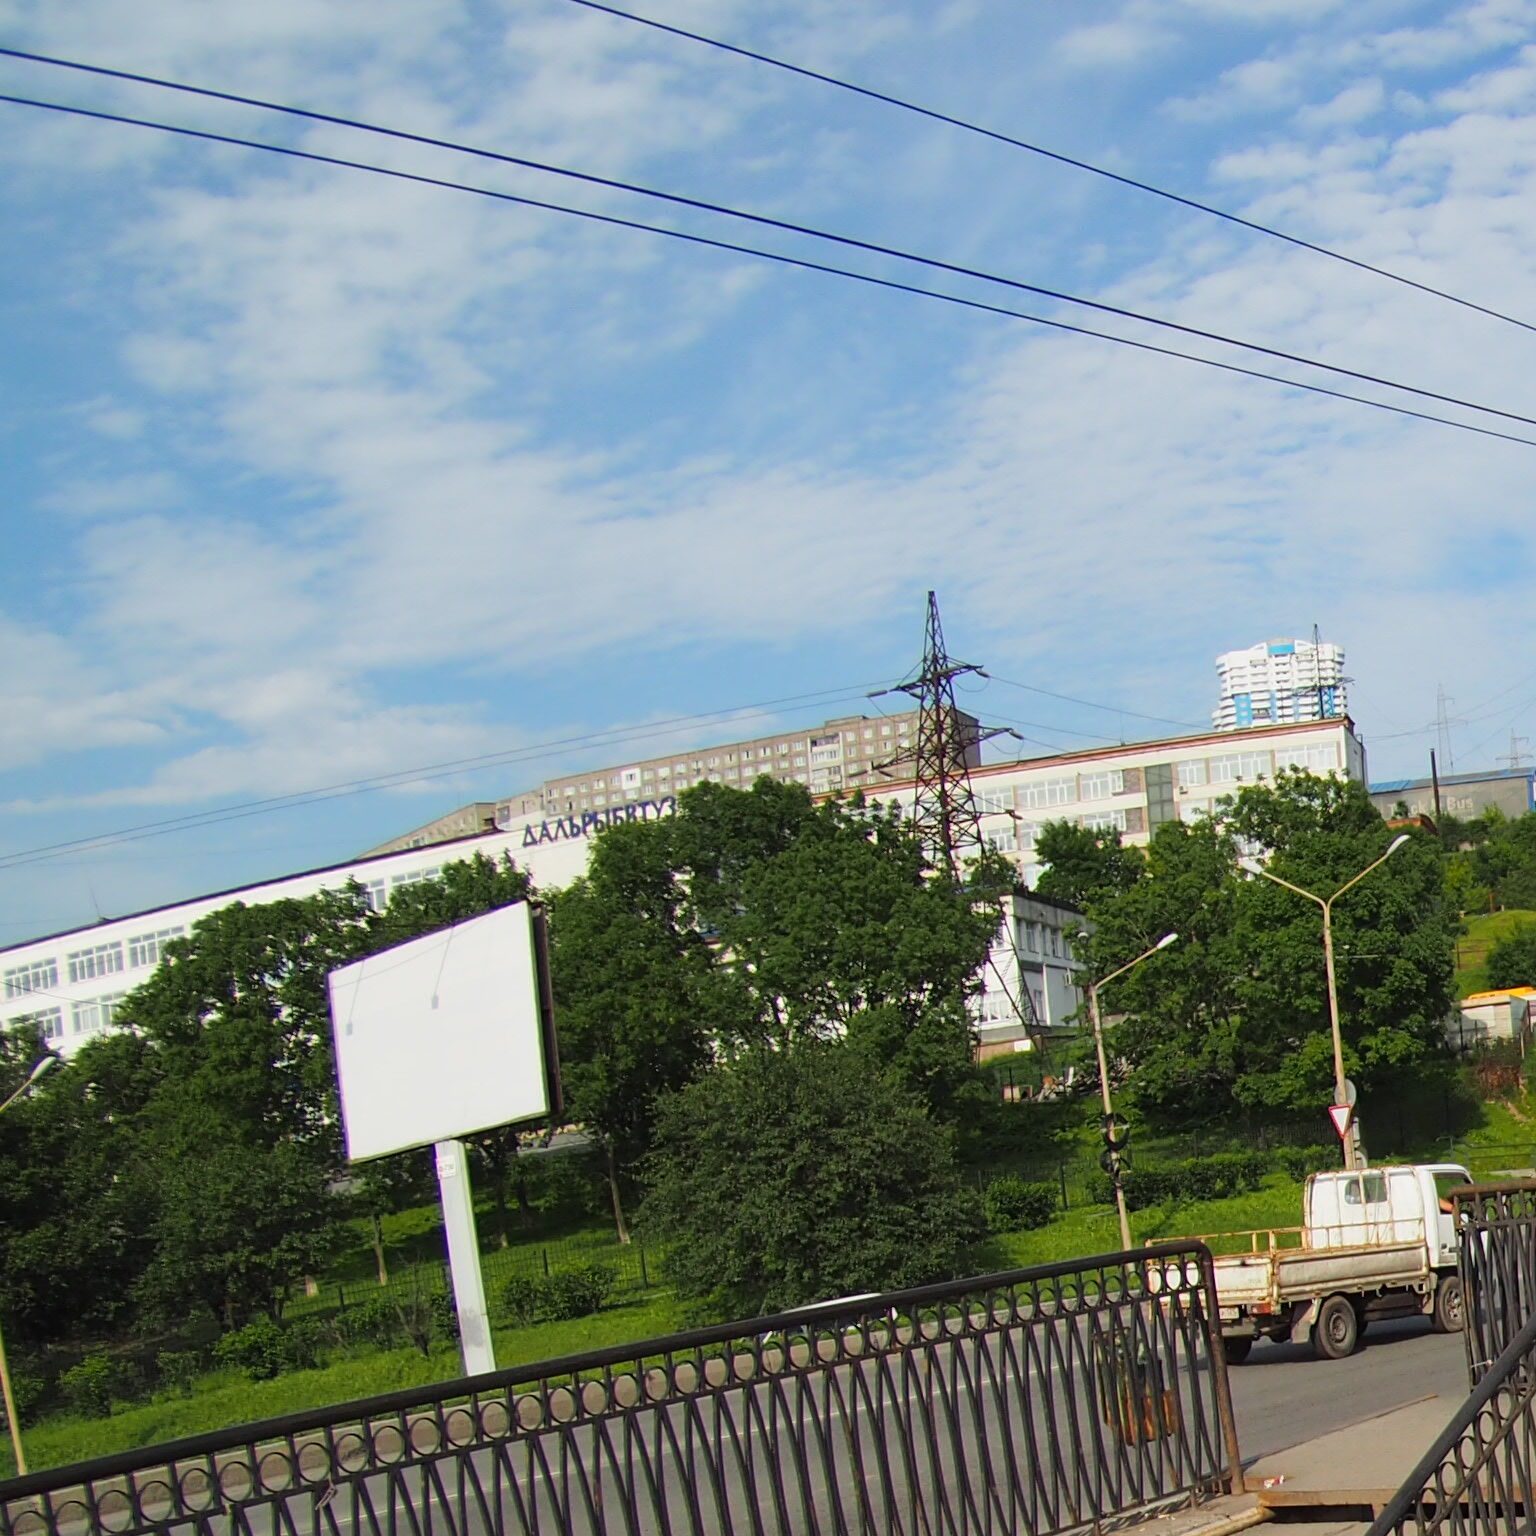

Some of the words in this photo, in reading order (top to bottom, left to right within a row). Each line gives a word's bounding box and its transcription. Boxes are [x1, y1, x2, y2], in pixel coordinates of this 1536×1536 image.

[522, 795, 677, 848] ДАЛЬРЫБВТУЗ
[1386, 800, 1427, 816] Tck
[1446, 796, 1473, 810] Bus
